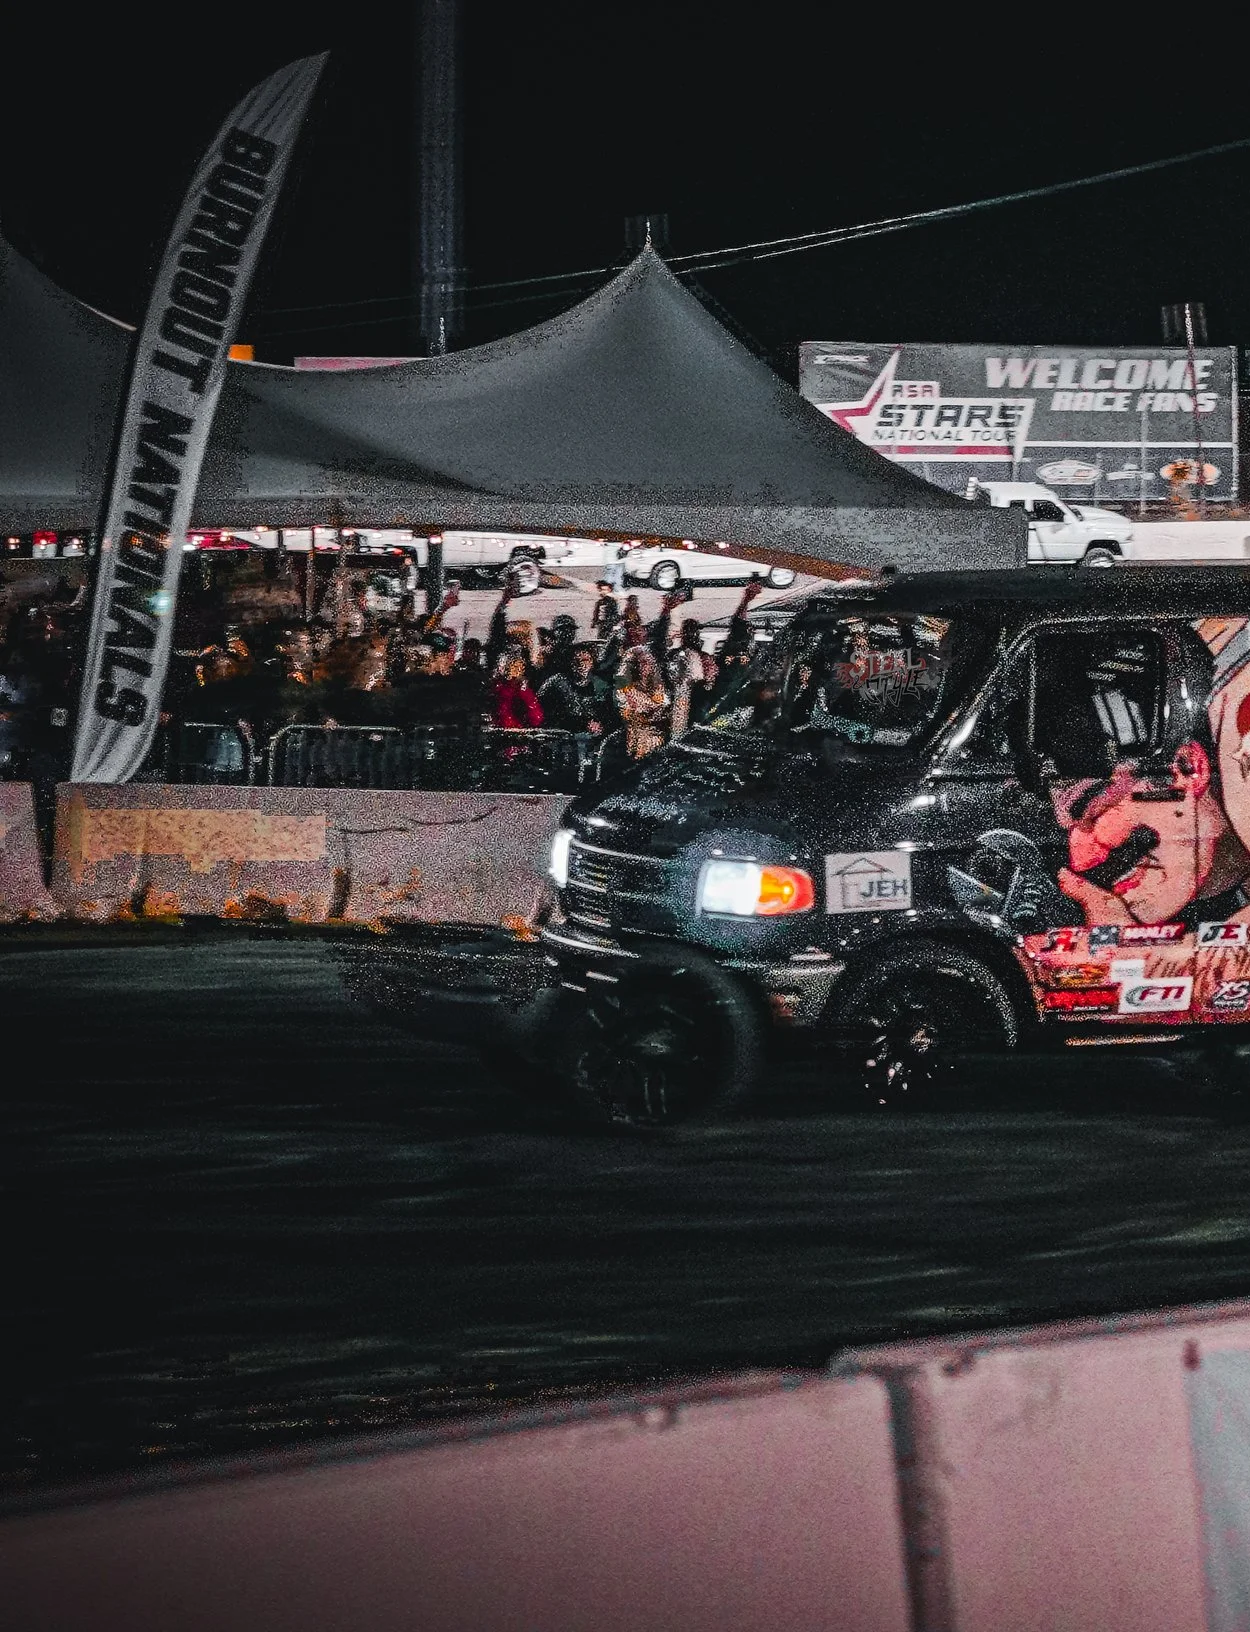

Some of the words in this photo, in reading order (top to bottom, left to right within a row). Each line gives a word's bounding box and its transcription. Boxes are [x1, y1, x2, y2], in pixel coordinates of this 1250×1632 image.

[151, 126, 280, 395] BURNOUT
[984, 357, 1216, 390] WELCOME
[1050, 391, 1133, 412] RACE
[1135, 392, 1219, 413] FANS
[876, 404, 1027, 428] STARS
[870, 430, 964, 442] NATIONAL
[97, 400, 194, 727] NATIONALS
[860, 879, 909, 899] JEH
